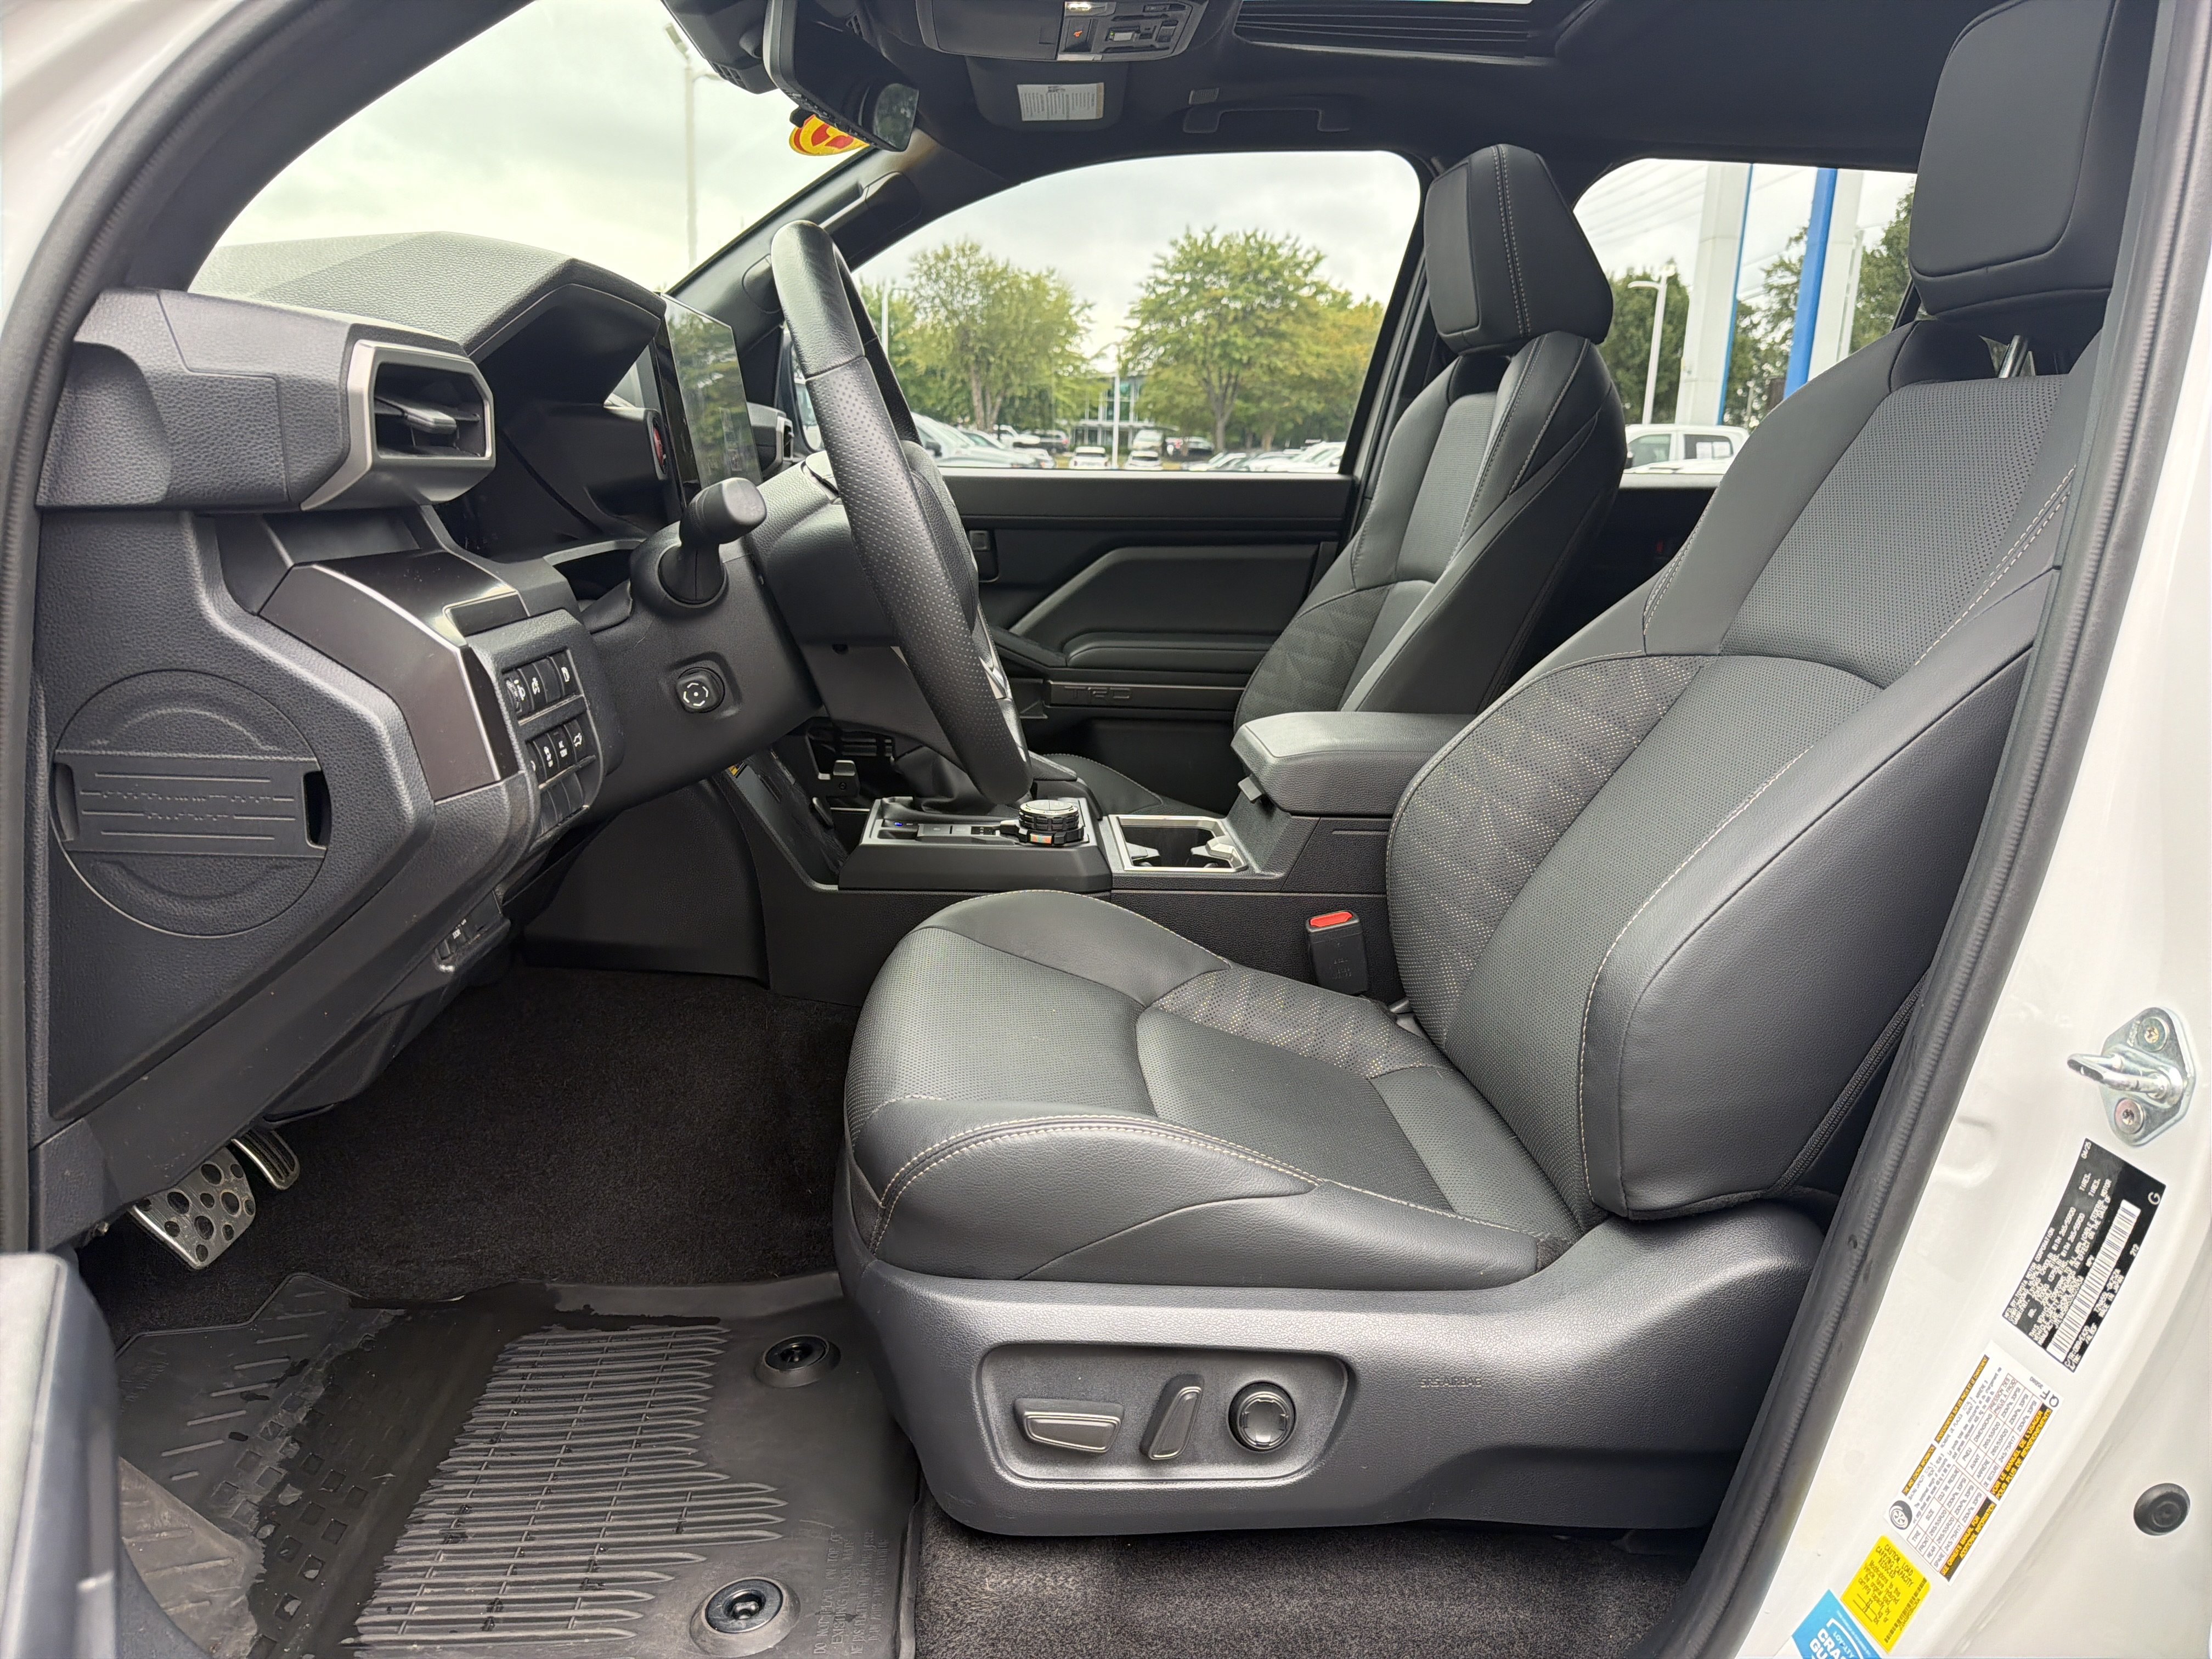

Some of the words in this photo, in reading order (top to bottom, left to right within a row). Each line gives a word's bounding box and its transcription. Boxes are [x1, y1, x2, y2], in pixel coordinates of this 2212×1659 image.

[2078, 1170, 2092, 1192] TIRES.
[2087, 1176, 2102, 1198] TIRES.
[2146, 1189, 2162, 1207] G
[2025, 1261, 2038, 1280] MOTOR
[2034, 1226, 2055, 1263] CORPORATION
[2028, 1322, 2039, 1339] THIS
[2098, 1177, 2113, 1198] MOTOR
[1990, 1480, 2001, 1496] VOIR
[2004, 1447, 2021, 1472] MANUEL
[2018, 1437, 2027, 1449] DE
[1995, 1481, 2007, 1499] POUR
[2005, 1466, 2017, 1483] PLUS
[2014, 1457, 2023, 1468] DE
[813, 1643, 827, 1654] DO
[827, 1548, 839, 1562] TOP
[831, 1599, 848, 1644] EXISTING
